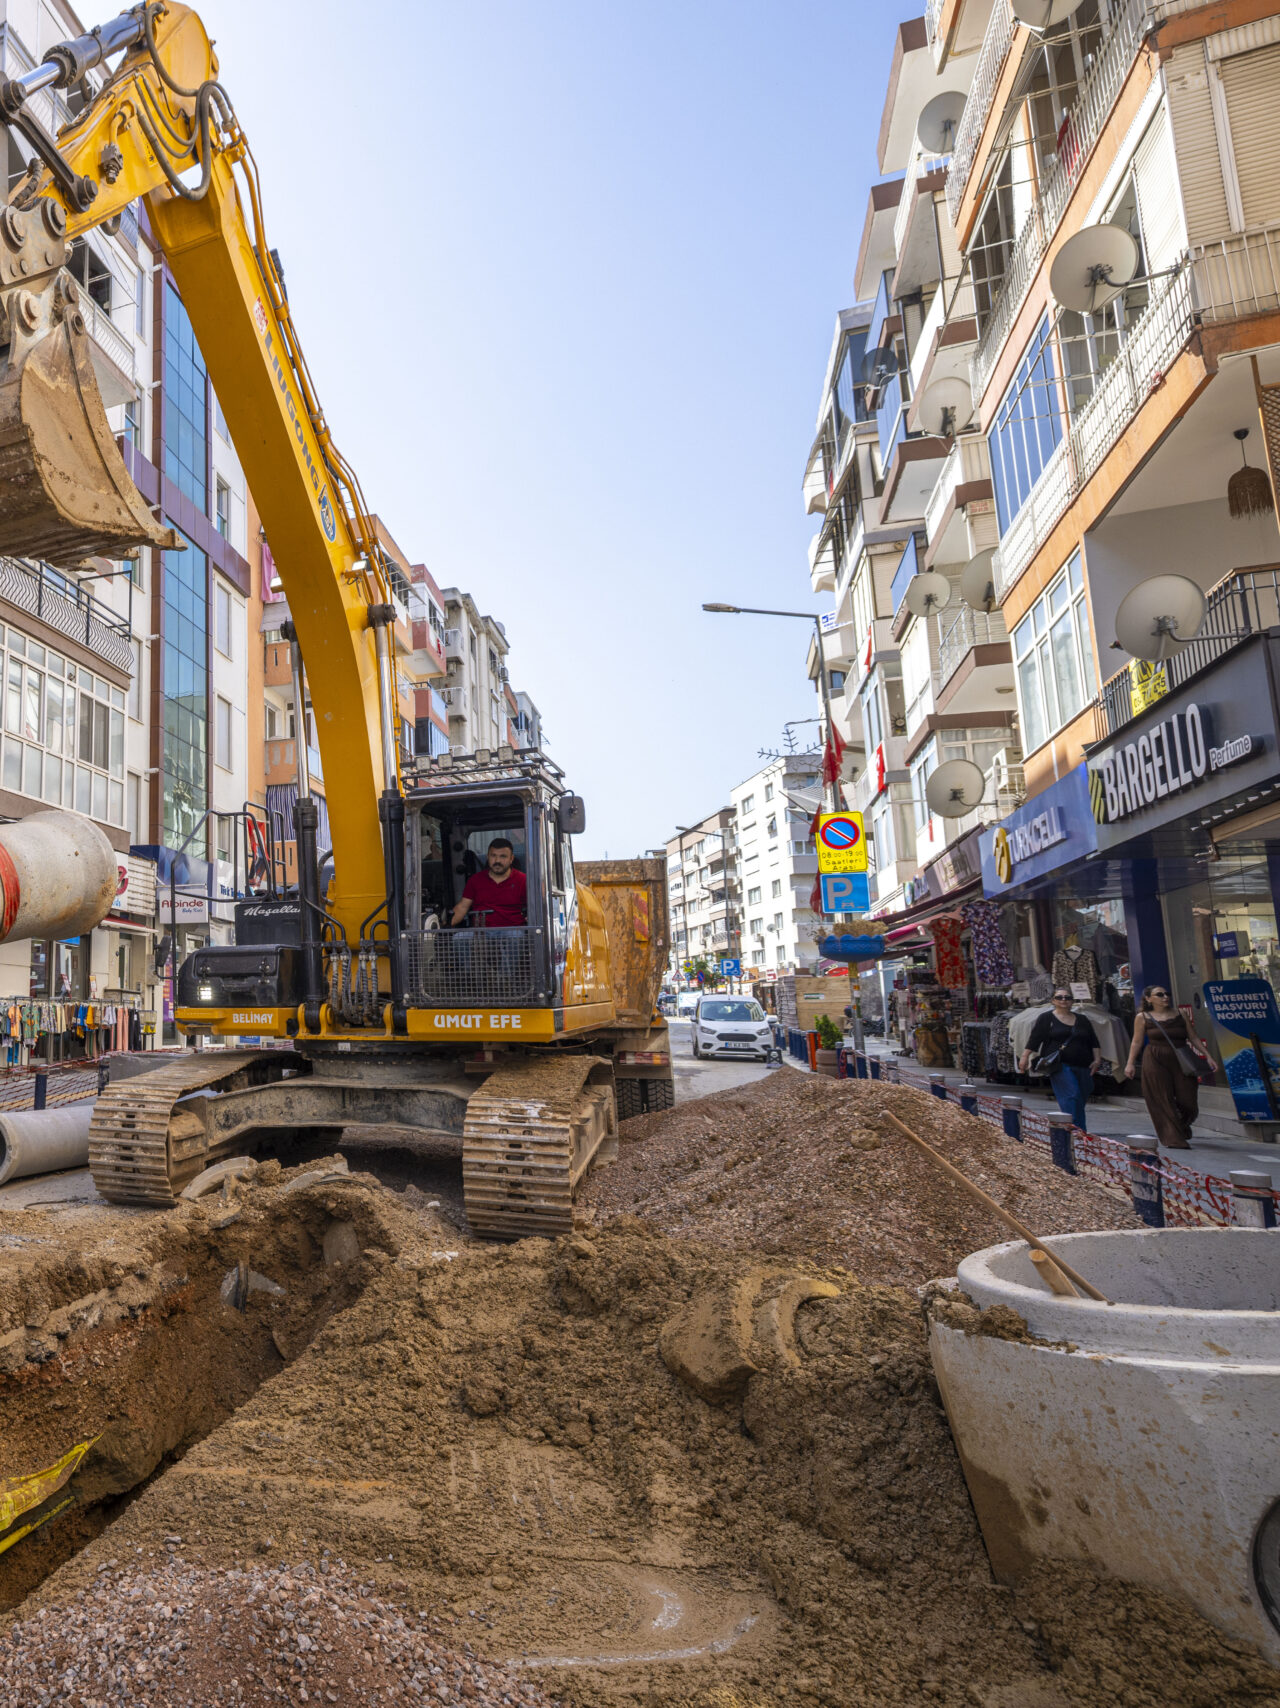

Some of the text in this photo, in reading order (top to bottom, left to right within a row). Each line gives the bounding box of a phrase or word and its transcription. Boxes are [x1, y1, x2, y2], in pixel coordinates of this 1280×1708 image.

[265, 331, 320, 491] LIUGONG
[1103, 703, 1252, 822] BARGELLO Perfume
[1005, 807, 1065, 866] TURKCELL
[825, 858, 862, 866] Saatleri
[826, 877, 853, 909] P
[243, 905, 301, 917] Maşalla
[723, 960, 734, 974] P
[1208, 985, 1224, 994] EV
[1211, 991, 1269, 1002] İNTERNETİ
[1214, 1002, 1268, 1011] BAŞVURU
[232, 1013, 273, 1024] BELİNAY
[433, 1014, 523, 1029] UMUT EFE
[1216, 1011, 1267, 1020] NOKTASI
